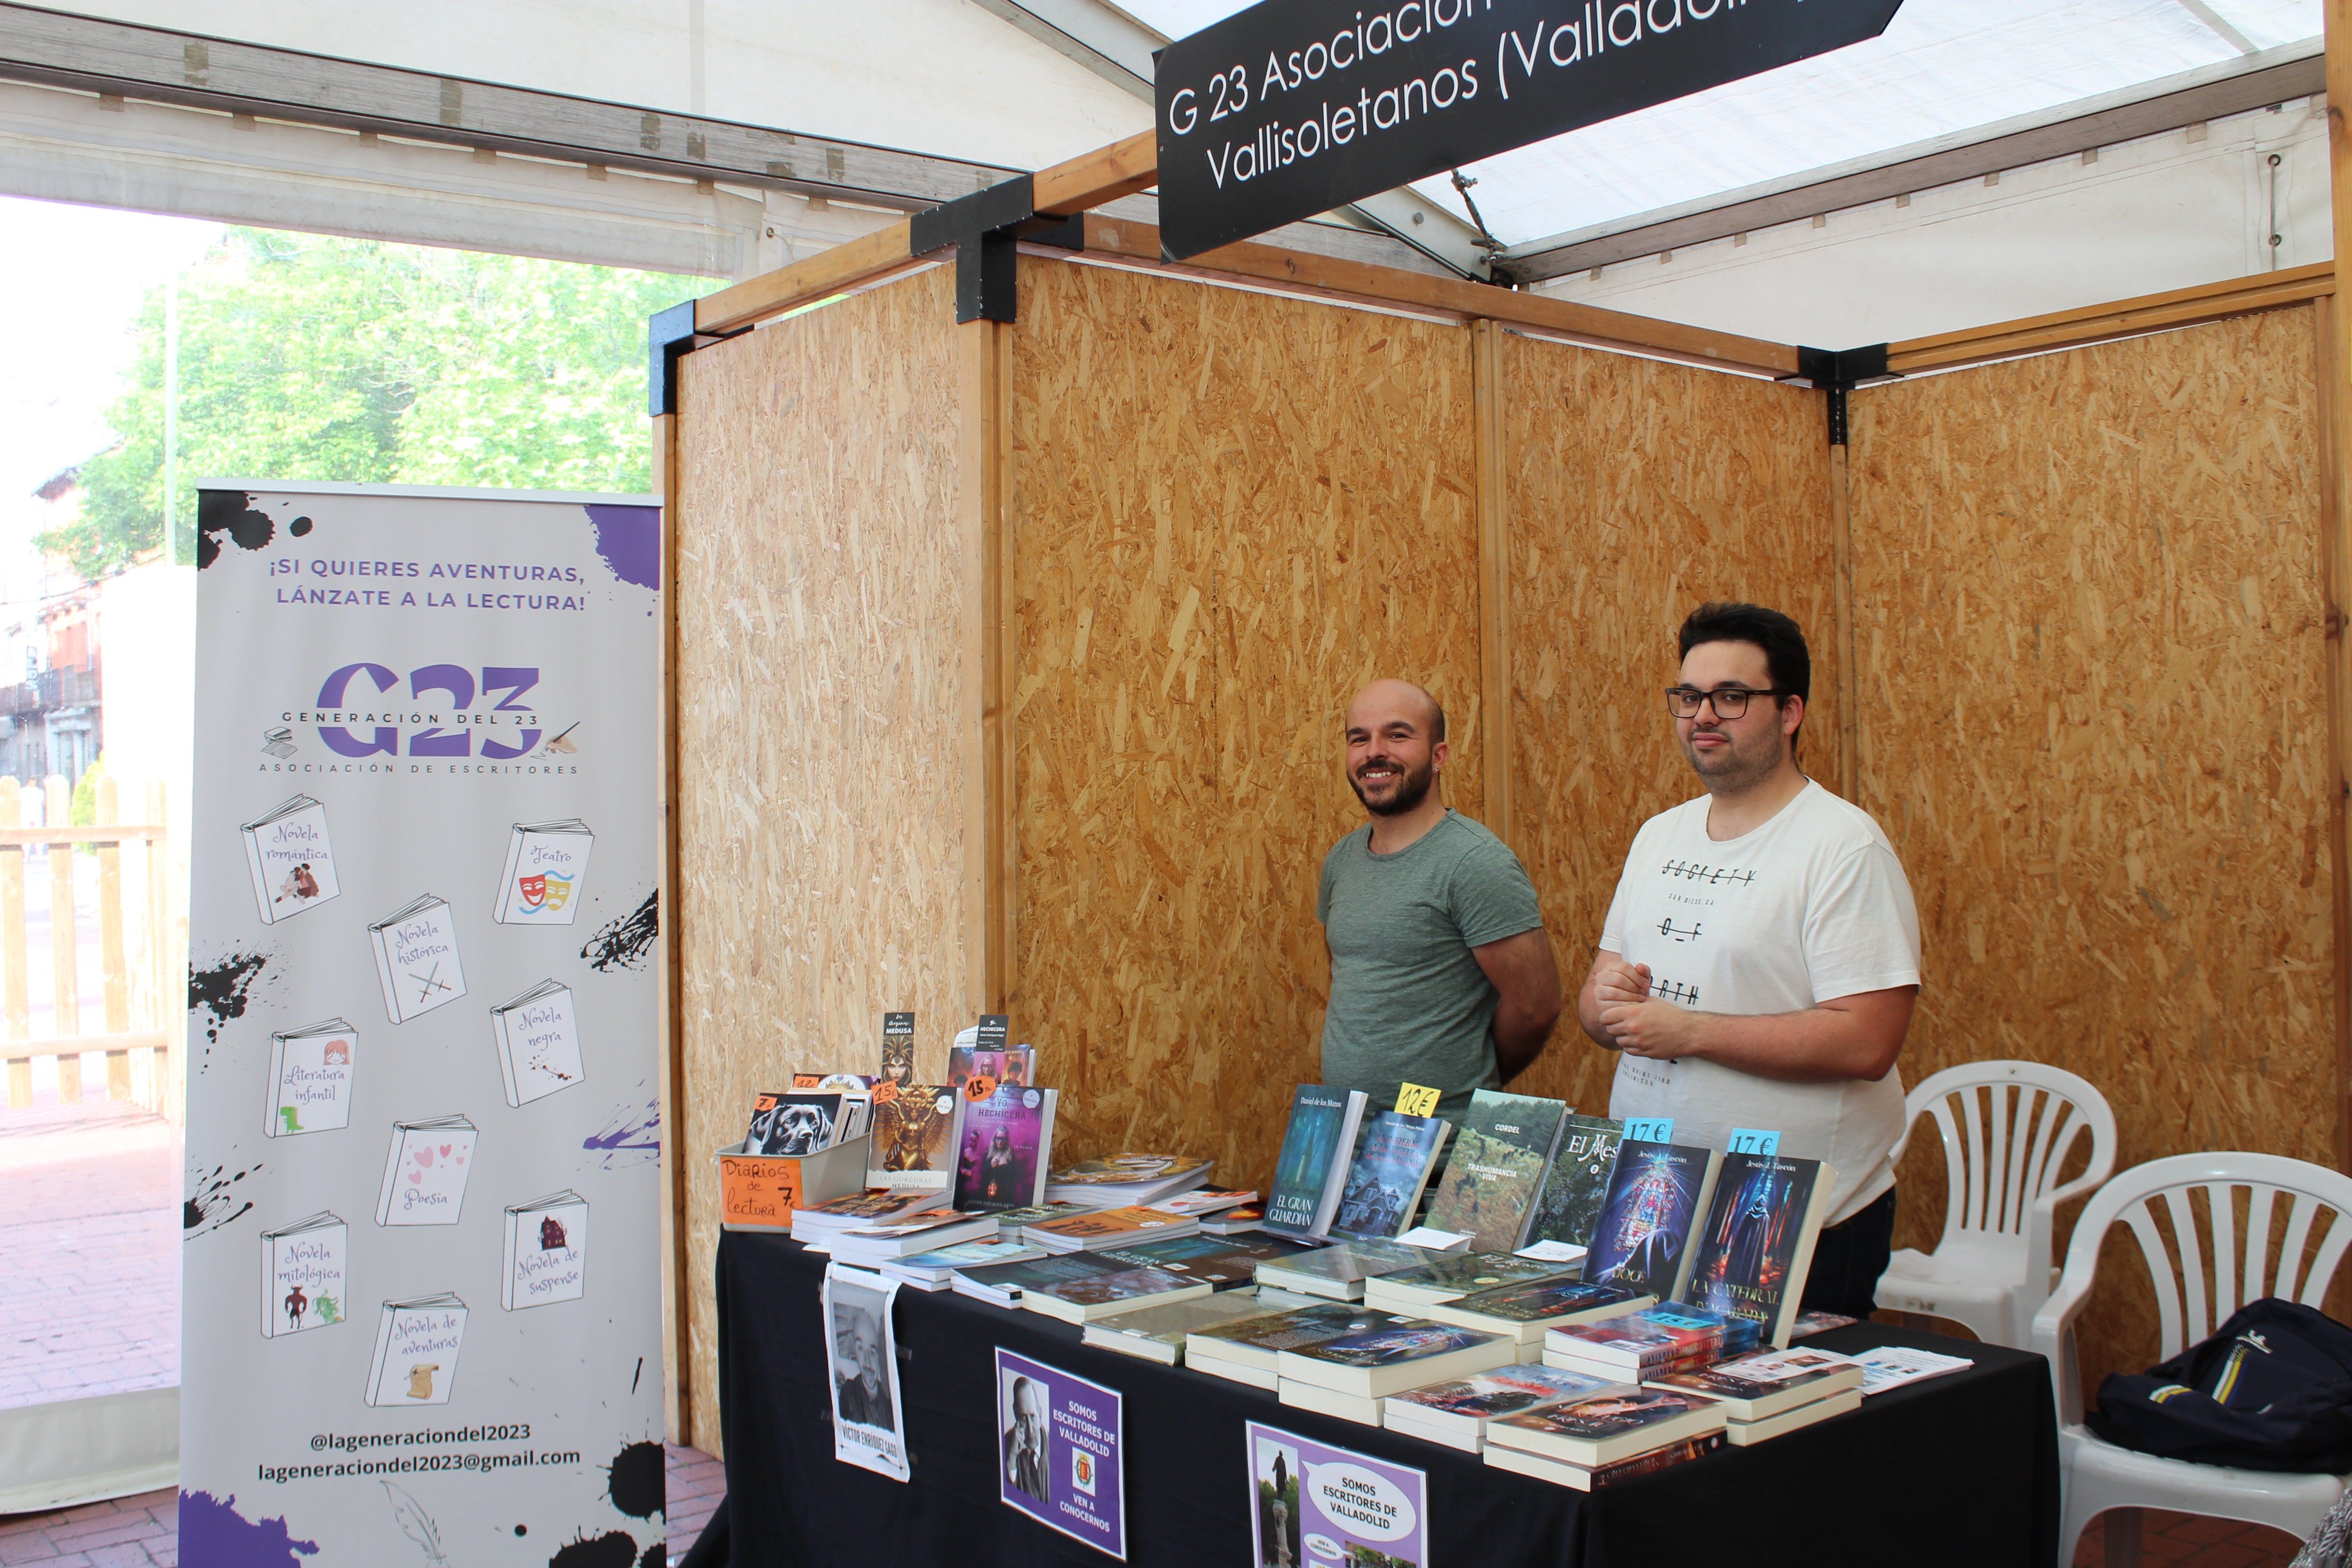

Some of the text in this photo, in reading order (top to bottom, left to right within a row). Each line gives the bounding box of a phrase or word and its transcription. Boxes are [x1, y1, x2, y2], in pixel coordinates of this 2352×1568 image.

[1169, 88, 1197, 135] G
[1209, 64, 1248, 122] 23
[1206, 59, 1478, 189] Vallisoletanos
[270, 558, 585, 585] ¡SI QUIERES AVENTURAS,
[276, 585, 586, 612] LÁNZATE A LA LECTURA!
[282, 709, 538, 725] GENERACIÓN DEL 23
[316, 663, 542, 760] G23
[259, 760, 578, 775] ASOCIACIÓN DE ESCRITORES
[273, 822, 319, 843] Novela
[265, 847, 328, 861] romántica
[530, 845, 572, 864] Teatro
[1661, 859, 1757, 887] SOCIETY
[396, 921, 439, 948] Novela
[397, 943, 449, 965] histórica
[519, 1007, 562, 1030] Novela
[527, 1032, 562, 1051] negra
[284, 1065, 345, 1086] Literatura
[295, 1085, 336, 1105] infantil
[1300, 1096, 1315, 1106] Daniel
[1315, 1098, 1320, 1106] de
[1327, 1099, 1342, 1108] Mozos
[1402, 1088, 1435, 1117] 12€
[978, 1109, 1026, 1120] HECHICERA
[1494, 1123, 1520, 1134] CORDEL
[1629, 1123, 1666, 1142] 17 €
[1567, 1135, 1588, 1154] El
[1734, 1136, 1773, 1156] 17 €
[1468, 1162, 1517, 1179] TRASHUMANCIA
[1482, 1173, 1497, 1182] VIVA
[747, 1180, 763, 1191] de
[404, 1189, 448, 1210] Poesía
[1277, 1195, 1313, 1212] EL GRAN
[1269, 1208, 1313, 1226] GUARDIÁN
[284, 1242, 331, 1264] Novela
[517, 1248, 579, 1280] Novela de
[277, 1264, 341, 1288] mitológica
[529, 1269, 580, 1296] suspense
[1612, 1268, 1646, 1284] DOCE
[1692, 1279, 1779, 1305] LA CATEDRAL
[395, 1314, 457, 1341] Novela de
[402, 1335, 458, 1355] aventuras
[1647, 1348, 1680, 1364] AVISPERO
[1644, 1365, 1677, 1381] AVISPERO
[1068, 1401, 1097, 1421] SOMOS
[1053, 1409, 1115, 1445] ESCRITORES DE
[310, 1424, 531, 1452] @lageneraciondel2023
[842, 1424, 897, 1459] VÍCTOR ENRÍQUEZ GAGO
[1059, 1426, 1109, 1457] VALLADOLID
[258, 1449, 581, 1484] lageneraciondel2023@gmail.com
[1342, 1477, 1376, 1496] SOMOS
[1073, 1493, 1094, 1512] VEN A
[1323, 1485, 1397, 1518] ESCRITORES DE
[1059, 1500, 1110, 1533] CONOCERNOS
[1330, 1501, 1390, 1529] VALLADOLID
